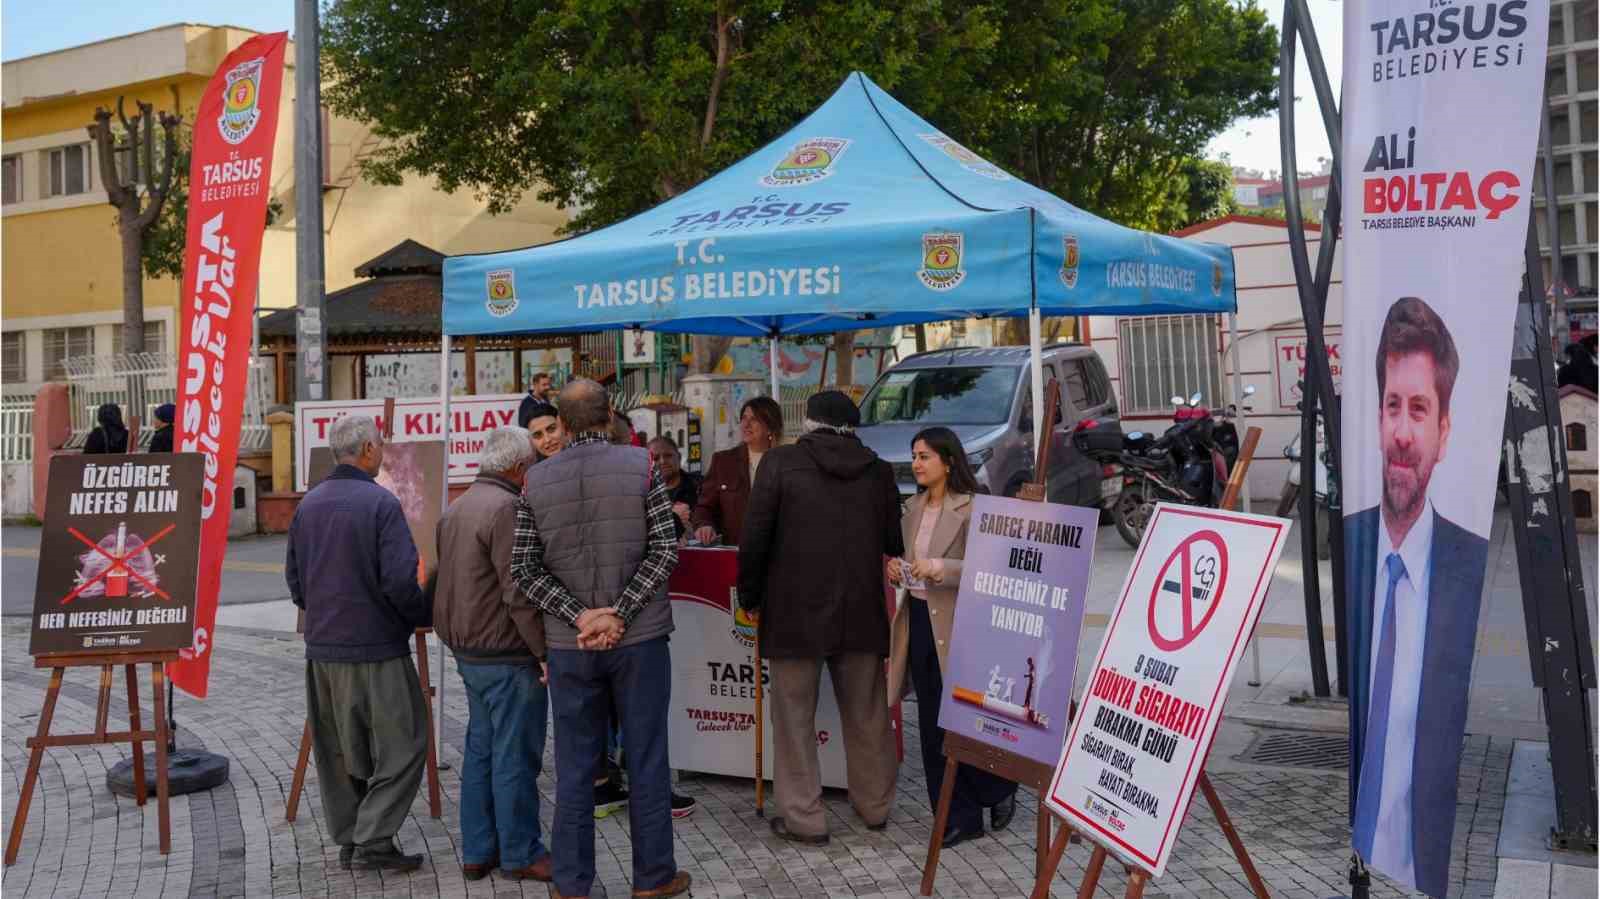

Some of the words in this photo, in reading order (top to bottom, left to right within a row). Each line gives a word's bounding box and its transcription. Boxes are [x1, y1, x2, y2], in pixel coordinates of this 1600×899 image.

[1371, 0, 1527, 56] TARSUS
[1373, 43, 1523, 82] BELEDİYESİ
[1363, 126, 1416, 172] ALİ
[203, 157, 262, 185] TARSUS
[751, 194, 780, 203] T.C.
[1363, 171, 1520, 219] BOLTAÇ
[671, 202, 851, 229] TARSUS
[1427, 215, 1476, 231] BAŞKANI
[675, 239, 725, 265] T.C.
[208, 235, 235, 319] Var
[1106, 261, 1146, 289] TARSUS
[574, 276, 674, 309] TARSUS
[182, 212, 224, 453] RSUS'TA
[1281, 341, 1341, 362] TÜK
[82, 462, 171, 489] ÖZGÜRCE
[69, 491, 128, 515] NEFES
[134, 490, 178, 513] ALIN
[979, 512, 1025, 539] SADECE
[1027, 520, 1084, 549] PARANIZ
[1009, 547, 1043, 574] DEĞİL
[1051, 586, 1069, 611] DE
[39, 613, 65, 629] HER
[69, 608, 132, 628] NEFESİNİZ
[136, 605, 187, 625] DEĞERLİ
[991, 605, 1044, 638] YANIYOR
[707, 661, 770, 685] TARS
[1134, 654, 1145, 674] 9
[1143, 657, 1179, 687] ŞUBAT
[687, 708, 757, 724] TARSUS'TA
[1093, 666, 1137, 711] DÜNYA
[1135, 684, 1206, 740] SİGARAYI
[696, 721, 733, 732] Gelecek
[734, 720, 753, 732] Var
[1094, 704, 1144, 748] BIRAKMA
[1142, 727, 1179, 764] GÜNÜ
[1081, 731, 1114, 765] SİGARAYI
[1110, 748, 1136, 779] BIRAK,
[1098, 768, 1125, 796] HAYATI
[1122, 781, 1159, 818] BIRAKMA.
